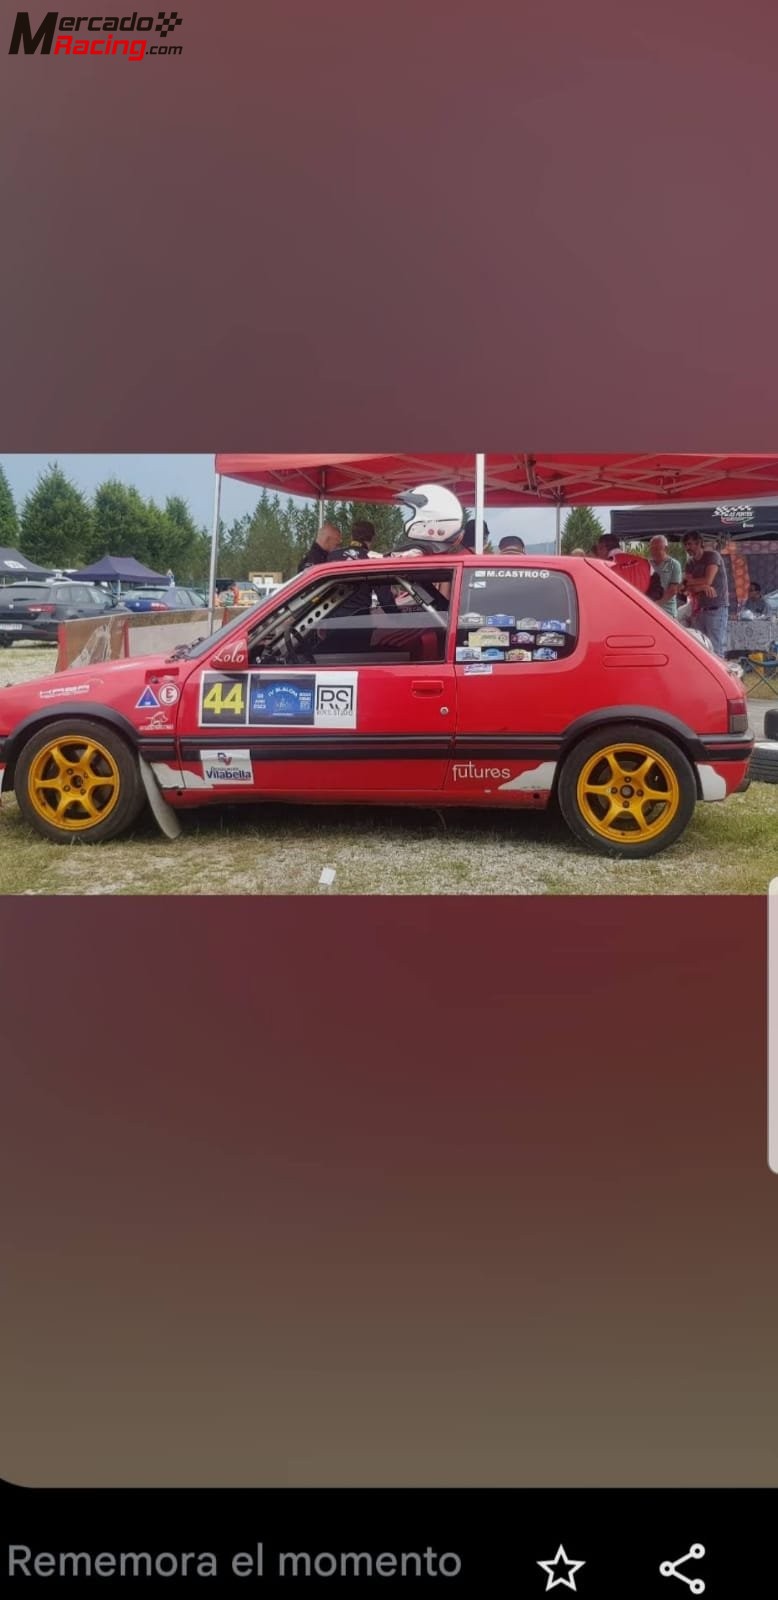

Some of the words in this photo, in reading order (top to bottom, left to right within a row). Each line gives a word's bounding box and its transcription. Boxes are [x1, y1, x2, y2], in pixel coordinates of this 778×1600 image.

[486, 570, 539, 579] M.CASTRO
[213, 642, 245, 663] Lolo
[204, 685, 244, 714] 44
[206, 769, 252, 780] Vilabella
[452, 760, 511, 782] futures
